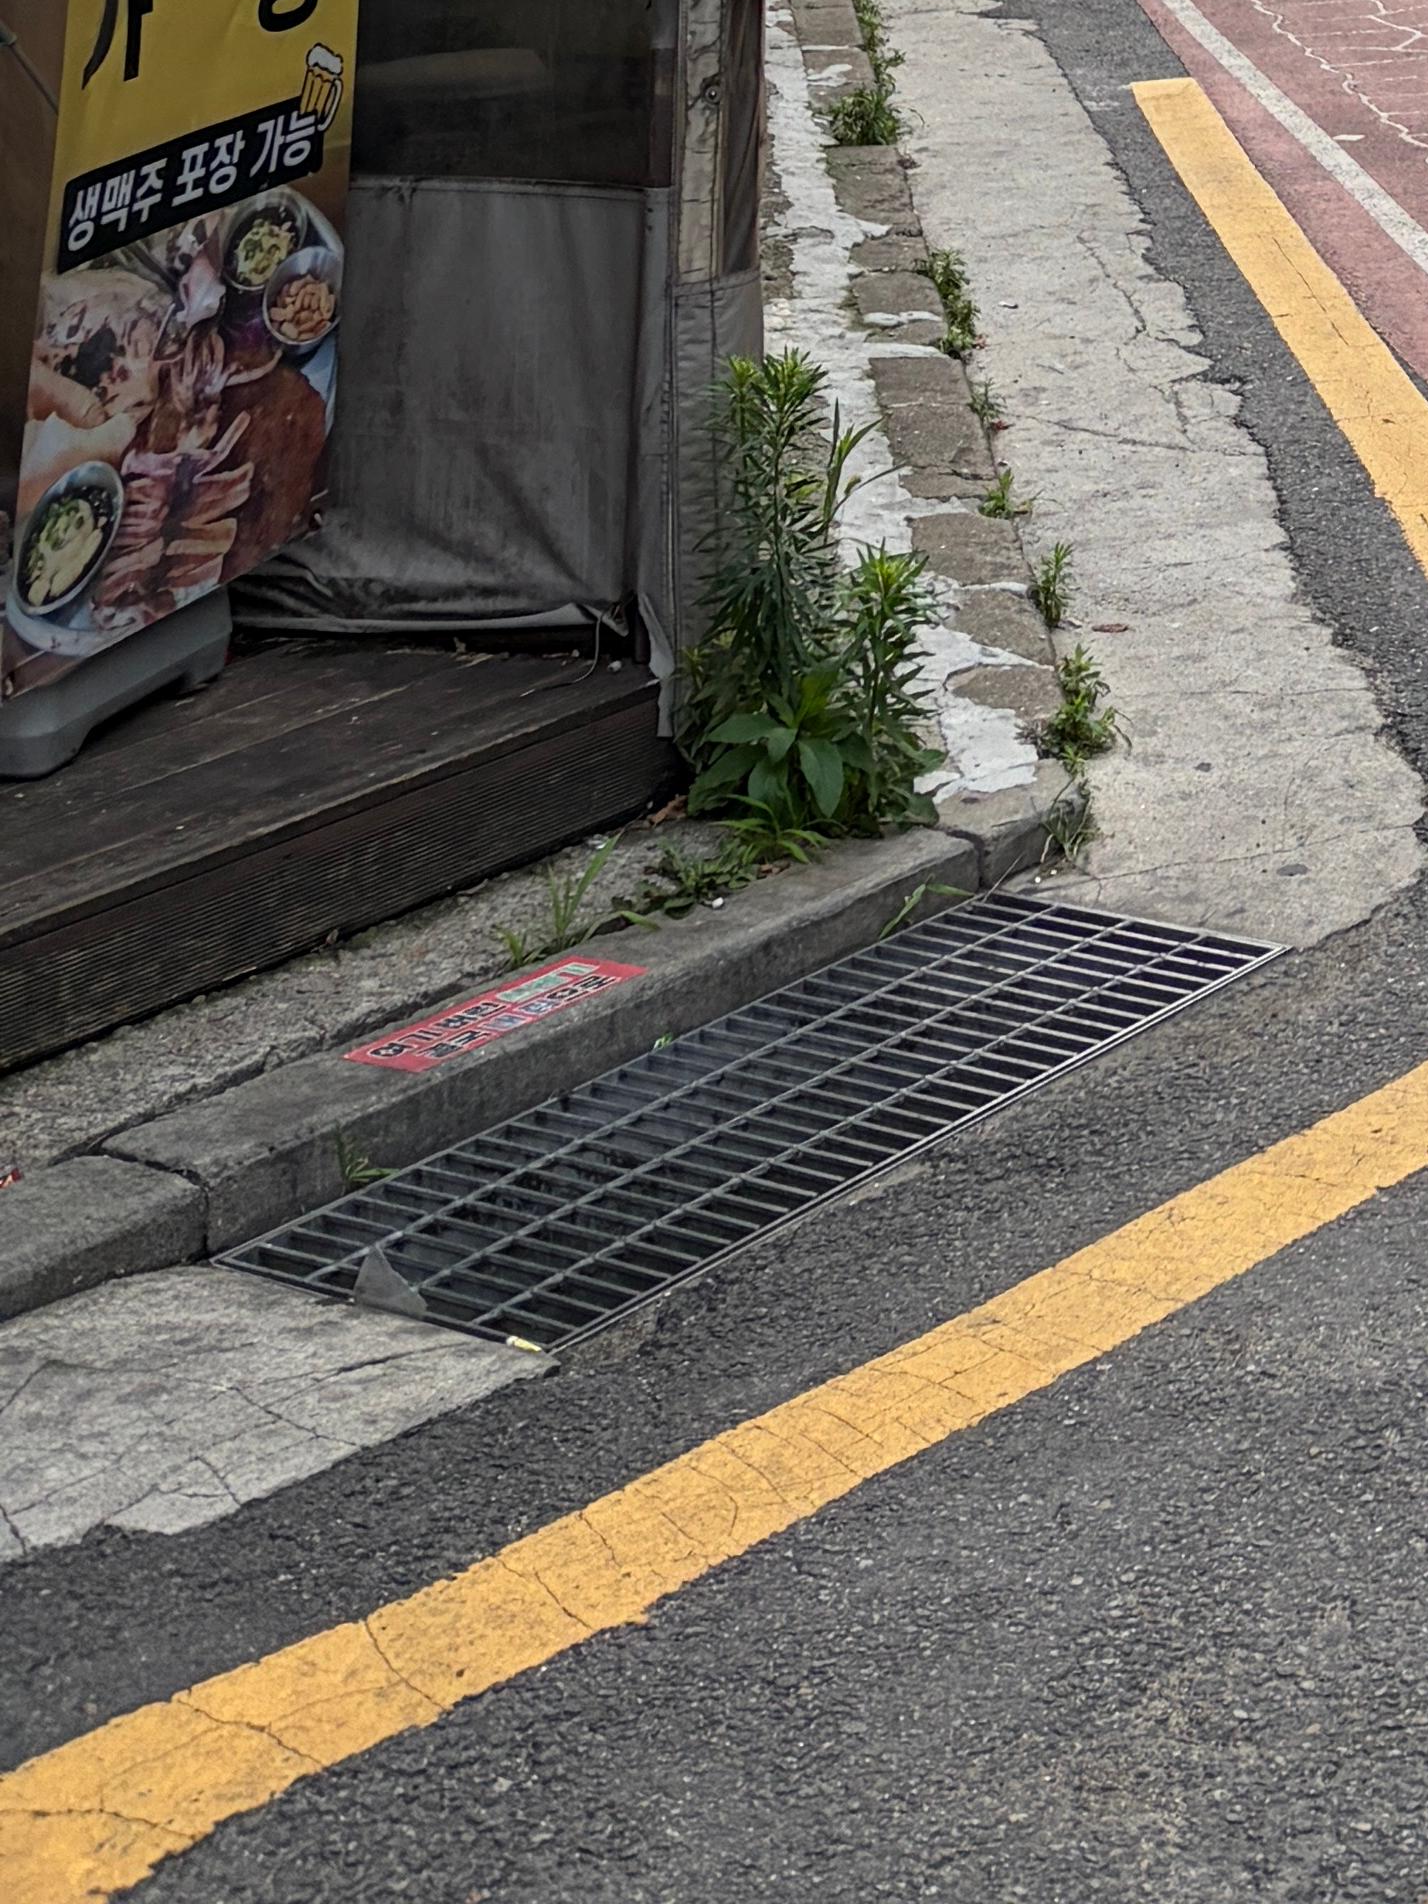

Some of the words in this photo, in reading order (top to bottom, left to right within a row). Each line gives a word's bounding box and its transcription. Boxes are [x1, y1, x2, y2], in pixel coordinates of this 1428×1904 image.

[66, 149, 167, 253] 생맥주
[174, 129, 246, 210] 포장
[251, 109, 318, 177] 가능
